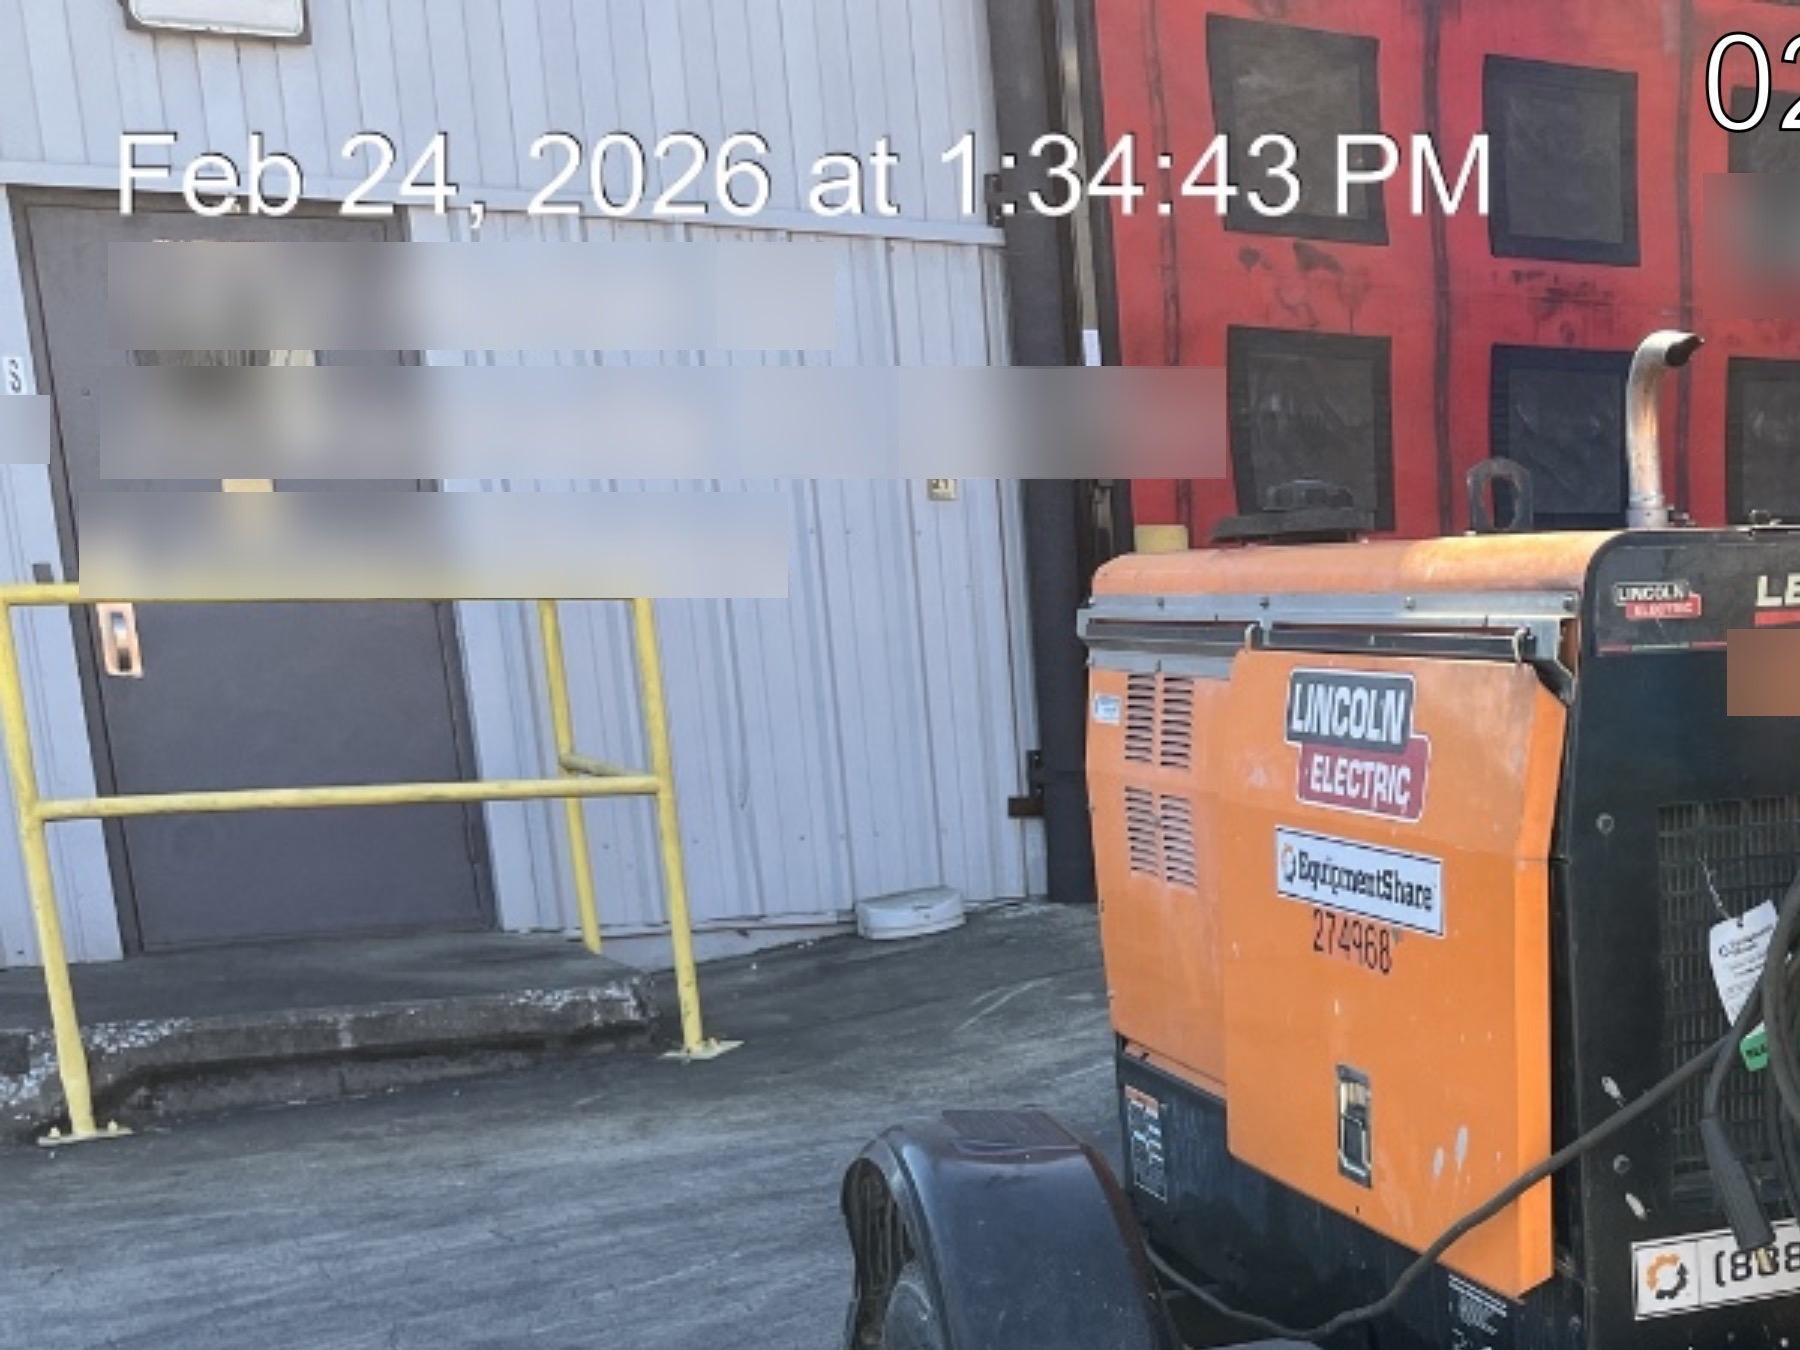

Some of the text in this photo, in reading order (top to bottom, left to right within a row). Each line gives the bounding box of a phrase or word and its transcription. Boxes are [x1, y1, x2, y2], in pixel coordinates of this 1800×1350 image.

[1291, 682, 1407, 746] LINCOLN
[1309, 752, 1412, 809] ELECTRIC
[1298, 850, 1433, 912] EquipmentShare
[1312, 908, 1392, 976] 274968
